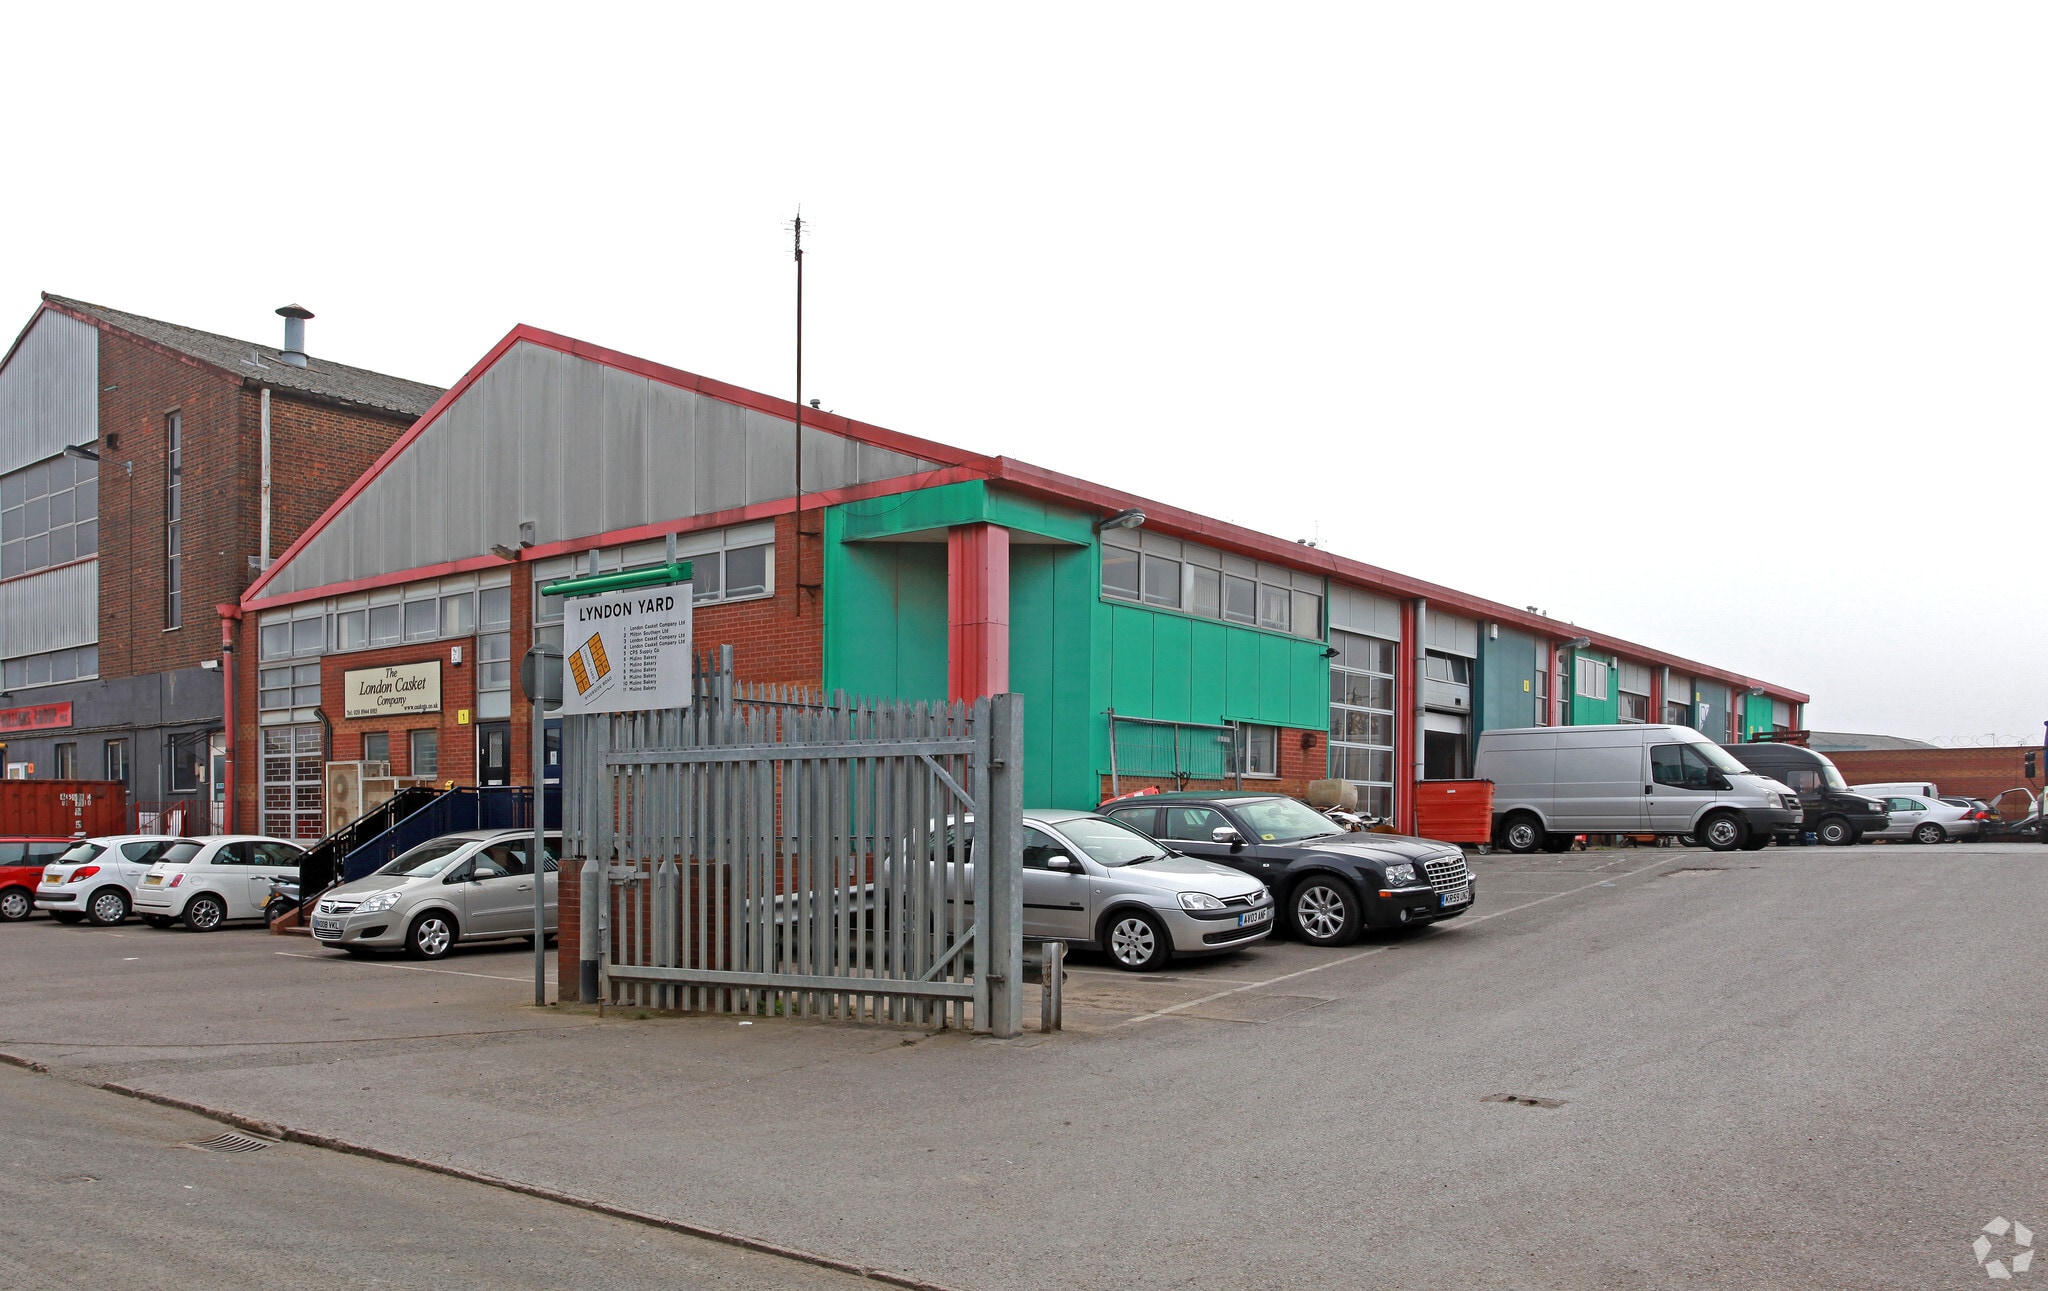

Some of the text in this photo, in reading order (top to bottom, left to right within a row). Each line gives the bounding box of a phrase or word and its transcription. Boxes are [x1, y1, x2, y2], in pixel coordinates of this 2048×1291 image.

[580, 596, 674, 622] LYNDON YARD
[386, 668, 398, 678] The
[359, 676, 426, 695] London Casket
[602, 676, 612, 686] ROAD
[377, 696, 406, 707] Company
[34, 708, 57, 724] GROUP
[1445, 893, 1460, 904] KR59
[1244, 912, 1257, 924] AV03
